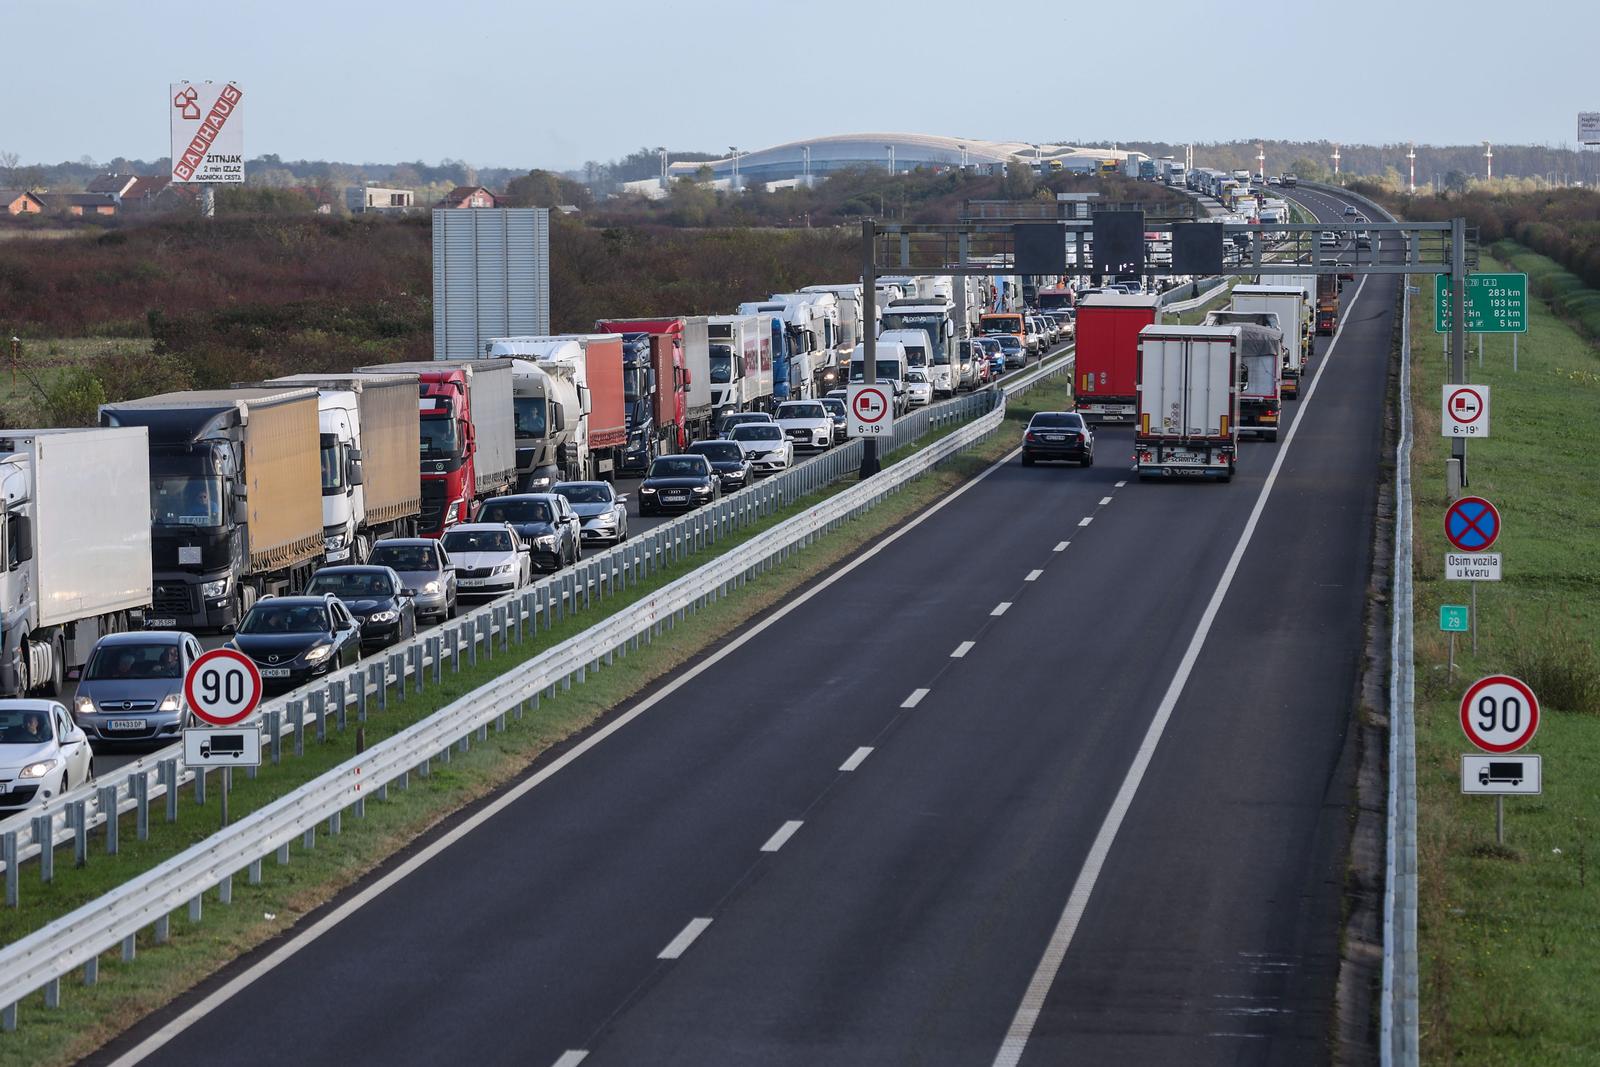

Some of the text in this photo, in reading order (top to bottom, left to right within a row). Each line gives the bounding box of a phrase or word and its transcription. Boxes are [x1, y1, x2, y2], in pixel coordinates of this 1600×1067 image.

[175, 86, 241, 179] BAUHAUS
[206, 152, 242, 164] ŽITNJAK
[203, 165, 241, 173] 2 min IZLAZ
[1488, 289, 1521, 297] 283 km
[1490, 299, 1506, 307] 193
[1507, 299, 1521, 307] km
[1494, 309, 1521, 317] 82 km
[1499, 320, 1521, 328] 5 km
[1448, 555, 1498, 566] Osim vozila
[1456, 567, 1490, 578] u kvaru
[1448, 617, 1460, 628] 29
[201, 668, 244, 706] 90
[1478, 695, 1521, 733] 90
